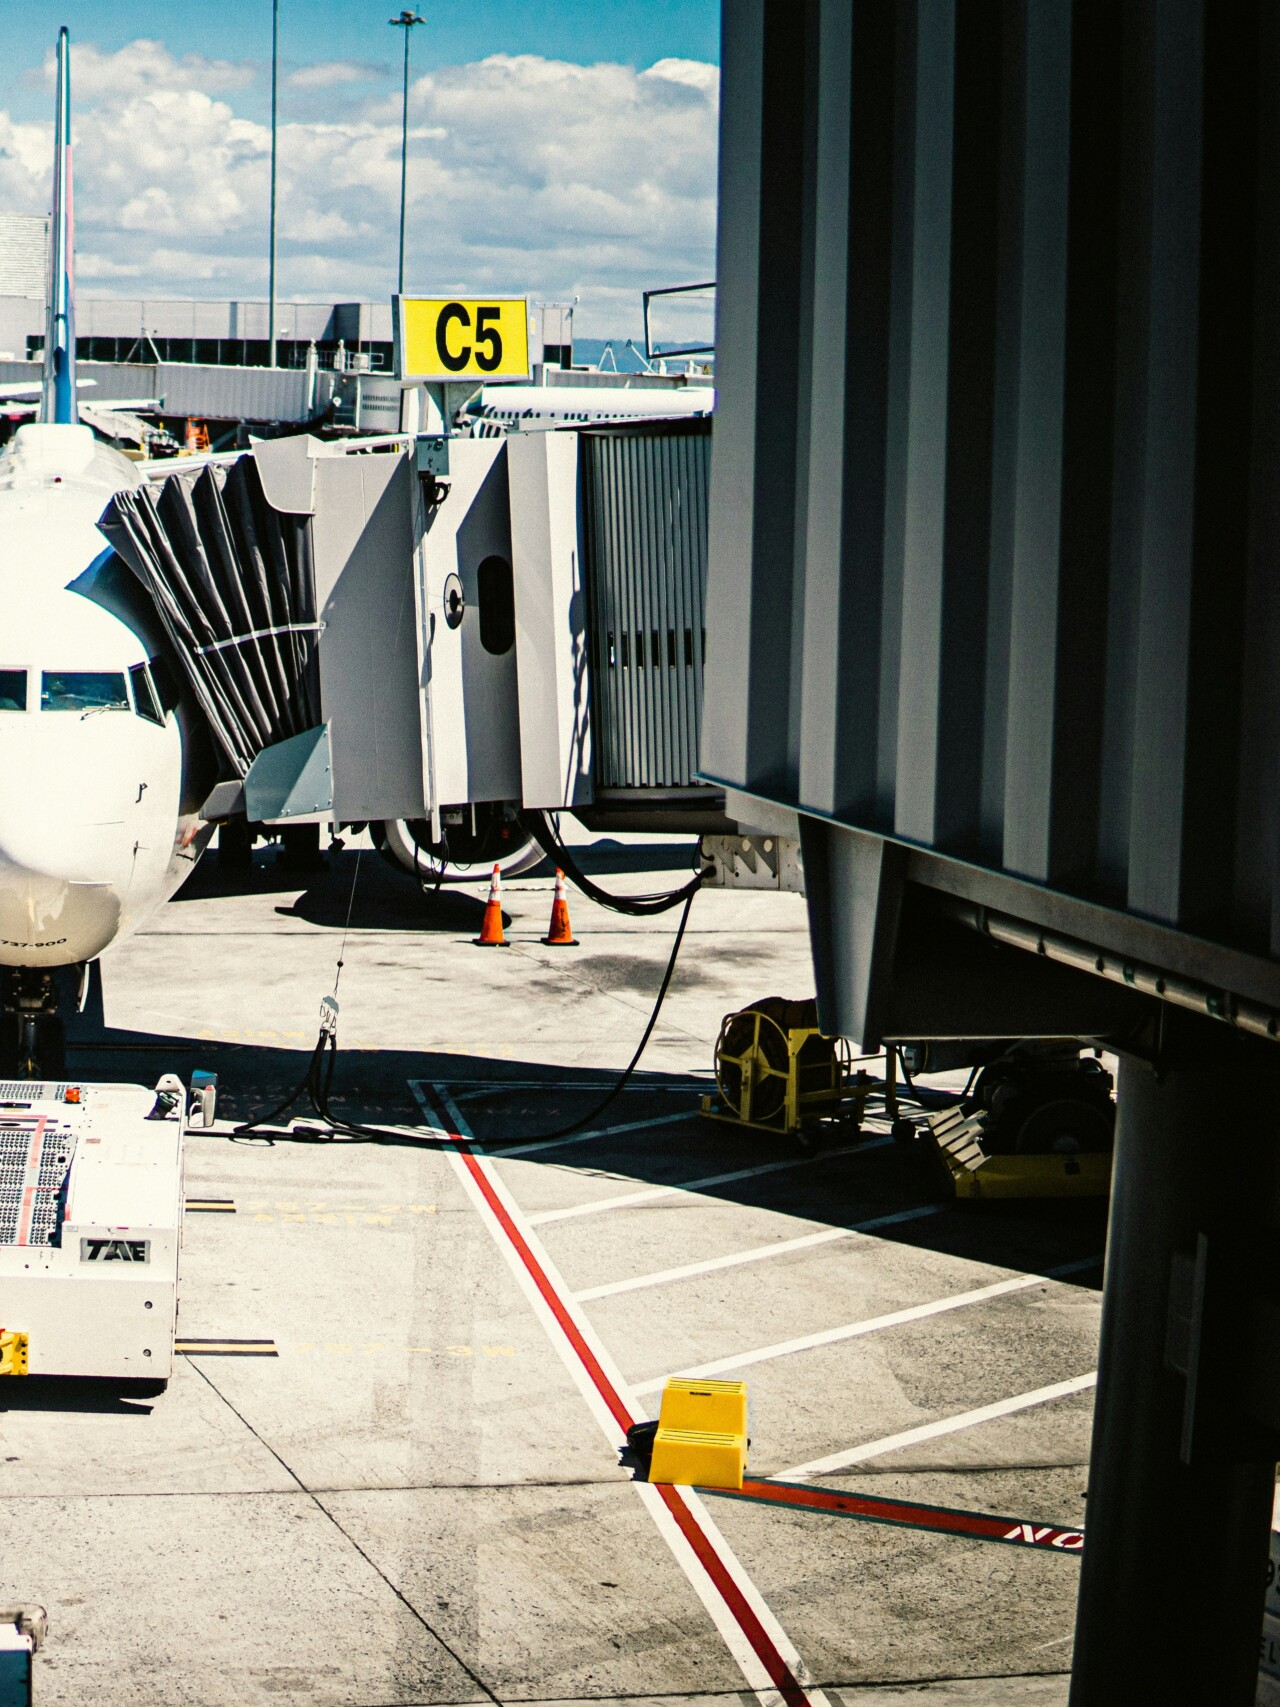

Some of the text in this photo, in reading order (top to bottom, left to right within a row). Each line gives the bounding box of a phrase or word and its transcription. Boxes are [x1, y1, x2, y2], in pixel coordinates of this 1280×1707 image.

[436, 303, 503, 372] C5
[86, 1239, 146, 1262] TAE
[1002, 1523, 1085, 1548] NO
